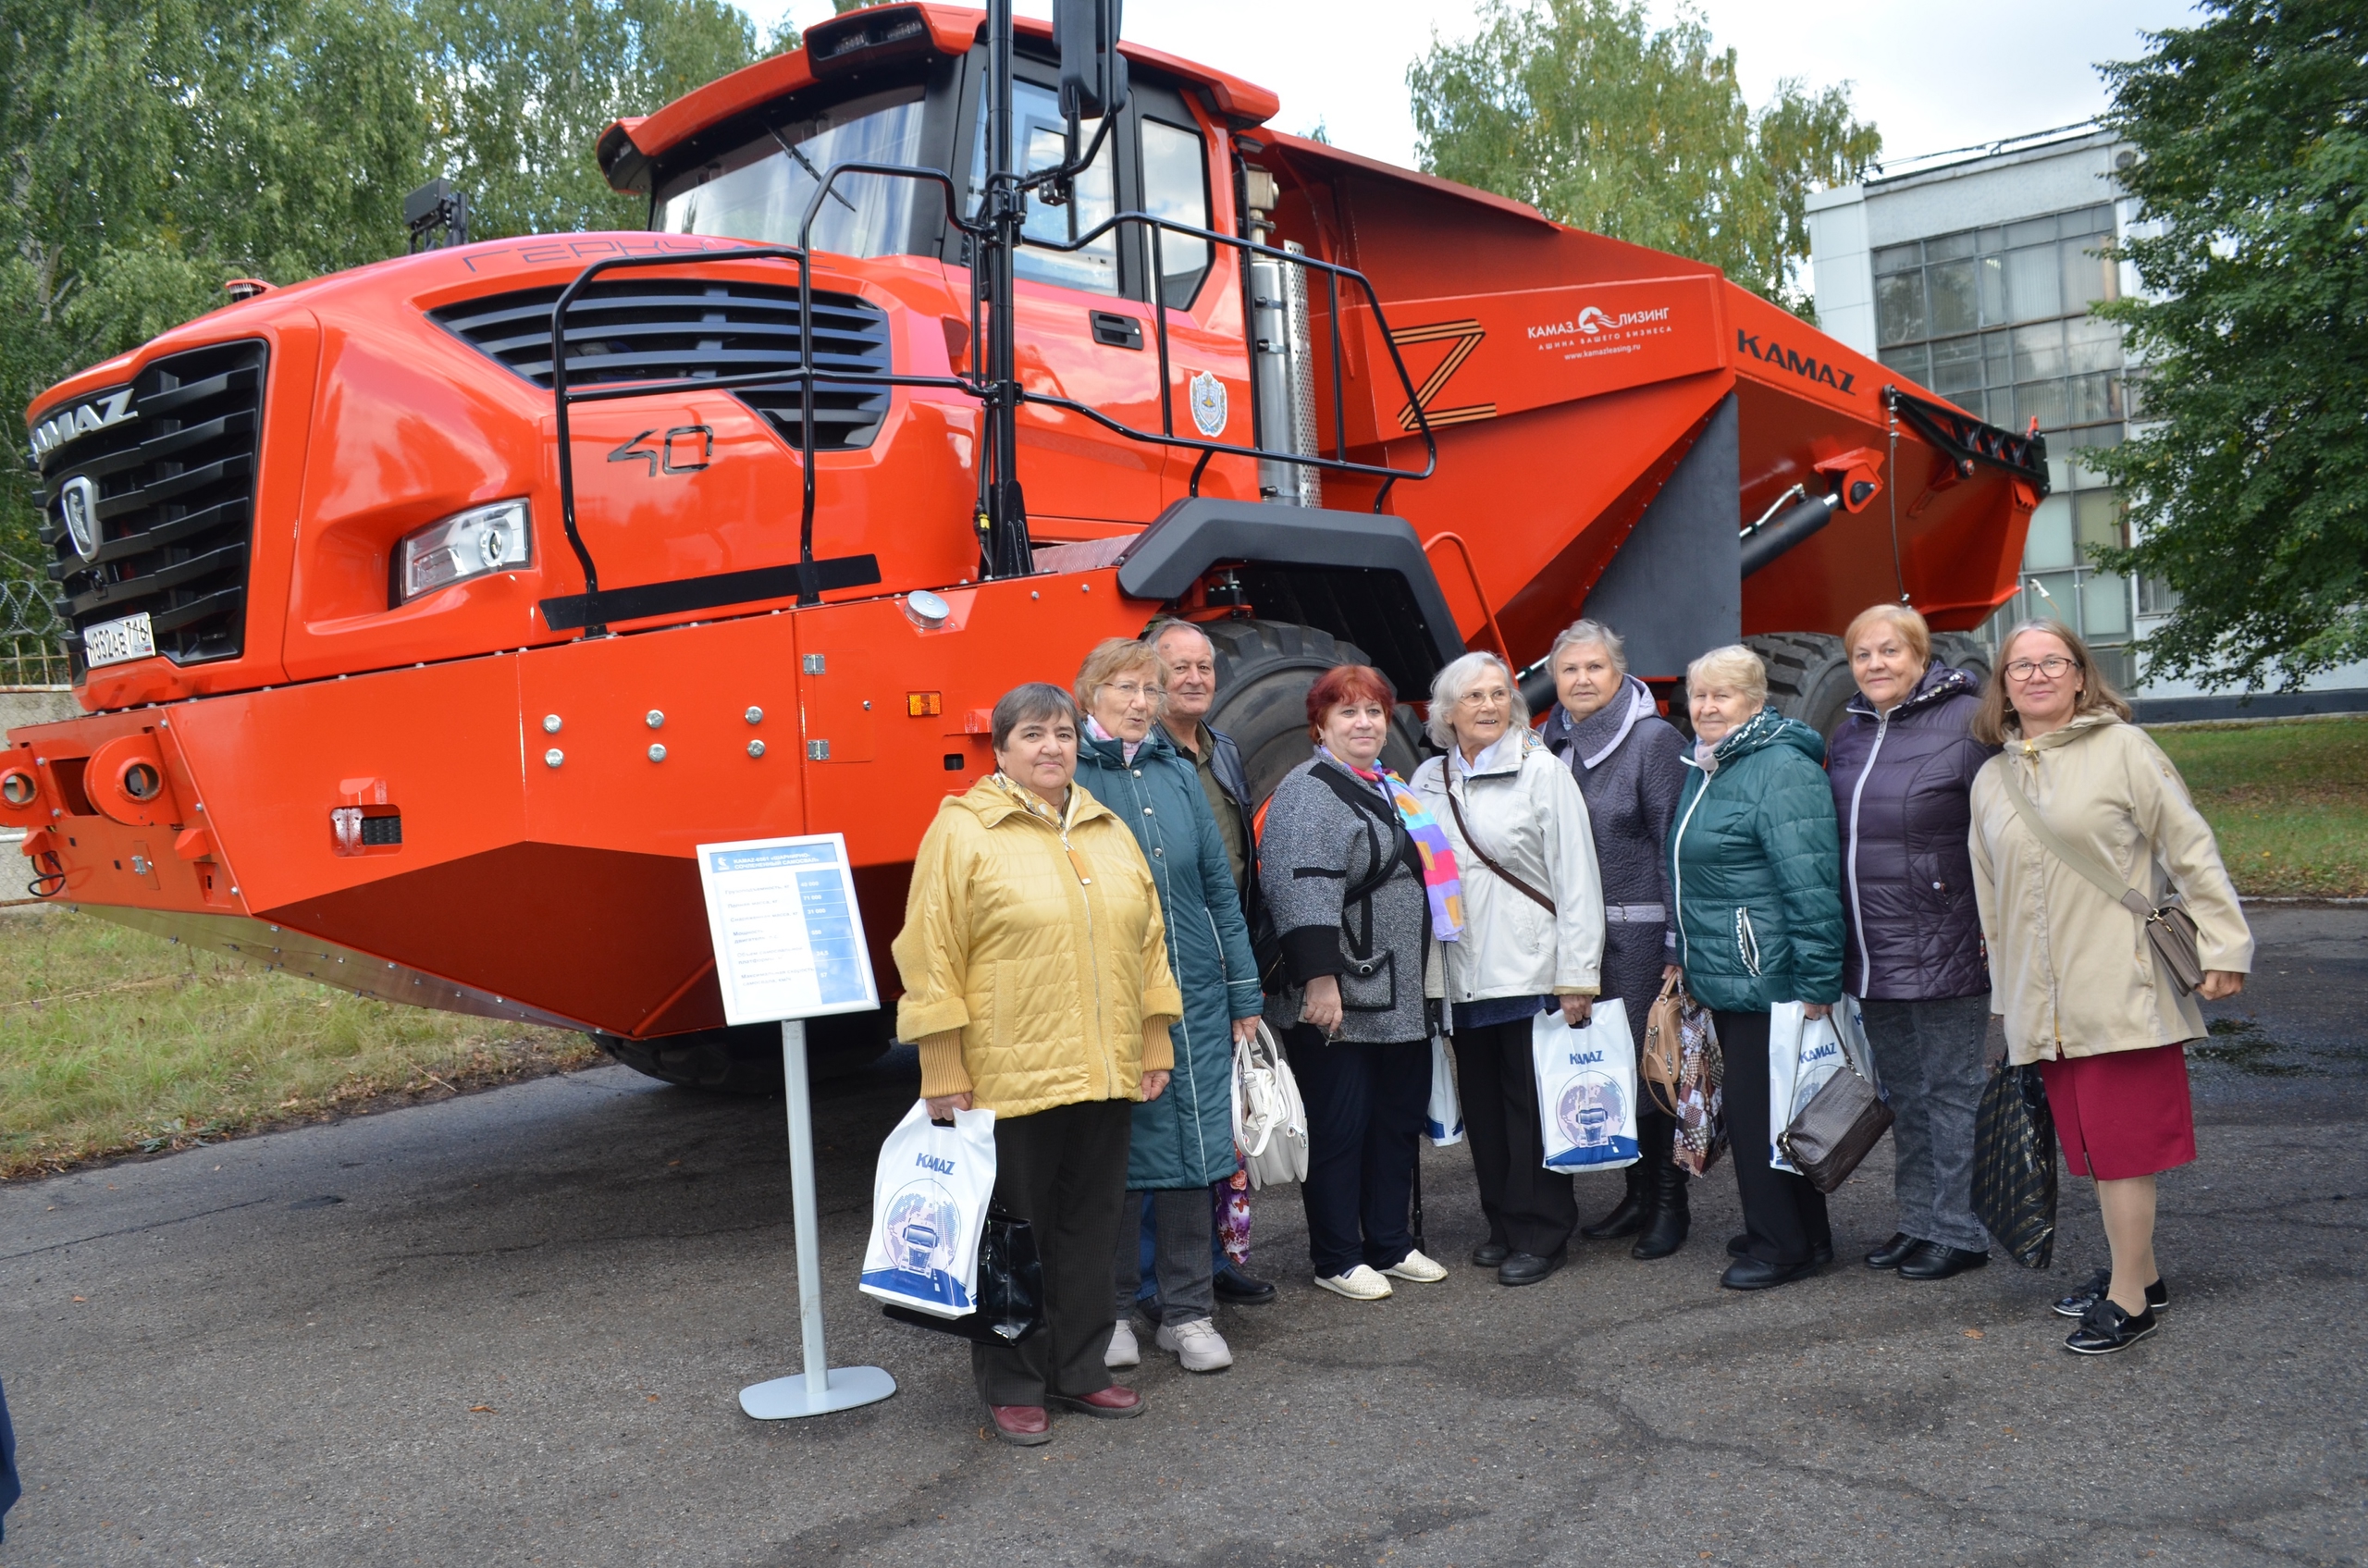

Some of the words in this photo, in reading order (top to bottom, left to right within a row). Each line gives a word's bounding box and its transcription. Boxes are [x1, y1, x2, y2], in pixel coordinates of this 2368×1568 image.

[1527, 321, 1574, 339] КАМАЗ
[1619, 307, 1670, 326] ЛИЗИНГ
[1580, 333, 1621, 344] ВАШЕГО
[1626, 326, 1672, 338] БИЗНЕСА
[1564, 343, 1641, 360] www.kamazleasing.ru
[1737, 327, 1856, 396] KAMAZ
[607, 425, 713, 477] 40
[1798, 1042, 1837, 1064] KAMAZ
